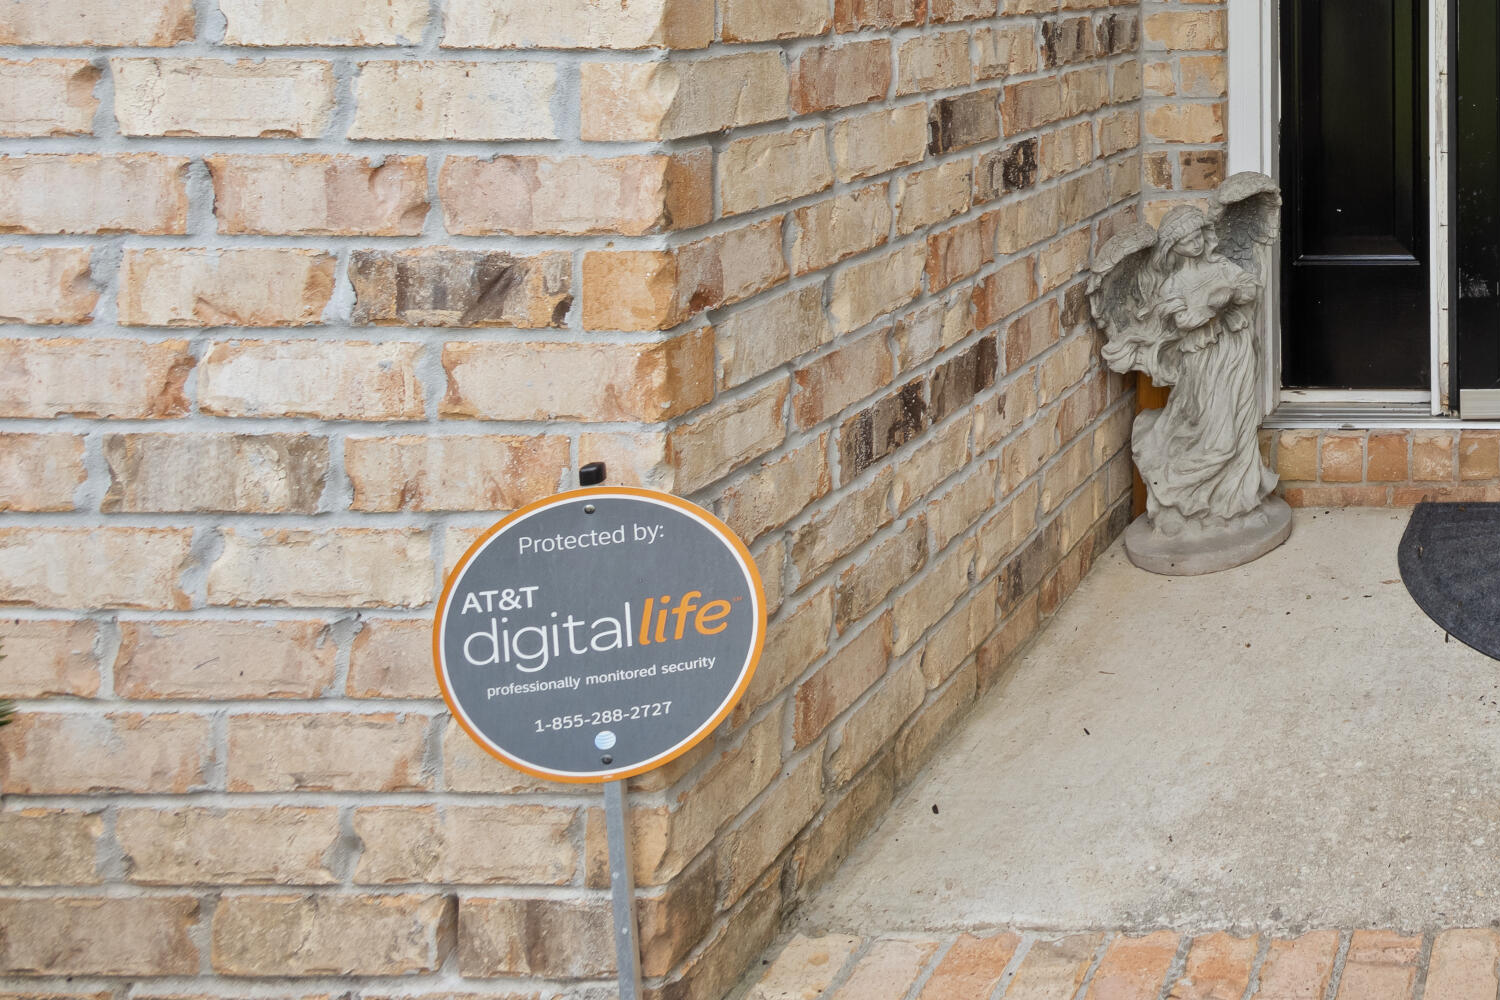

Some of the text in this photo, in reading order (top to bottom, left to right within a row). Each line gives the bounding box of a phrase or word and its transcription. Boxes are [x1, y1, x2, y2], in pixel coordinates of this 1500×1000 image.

[518, 523, 665, 554] Protected by:
[461, 586, 539, 615] AT&T
[487, 656, 716, 699] professionally monitored security
[535, 701, 673, 733] 1-855-288-2727
